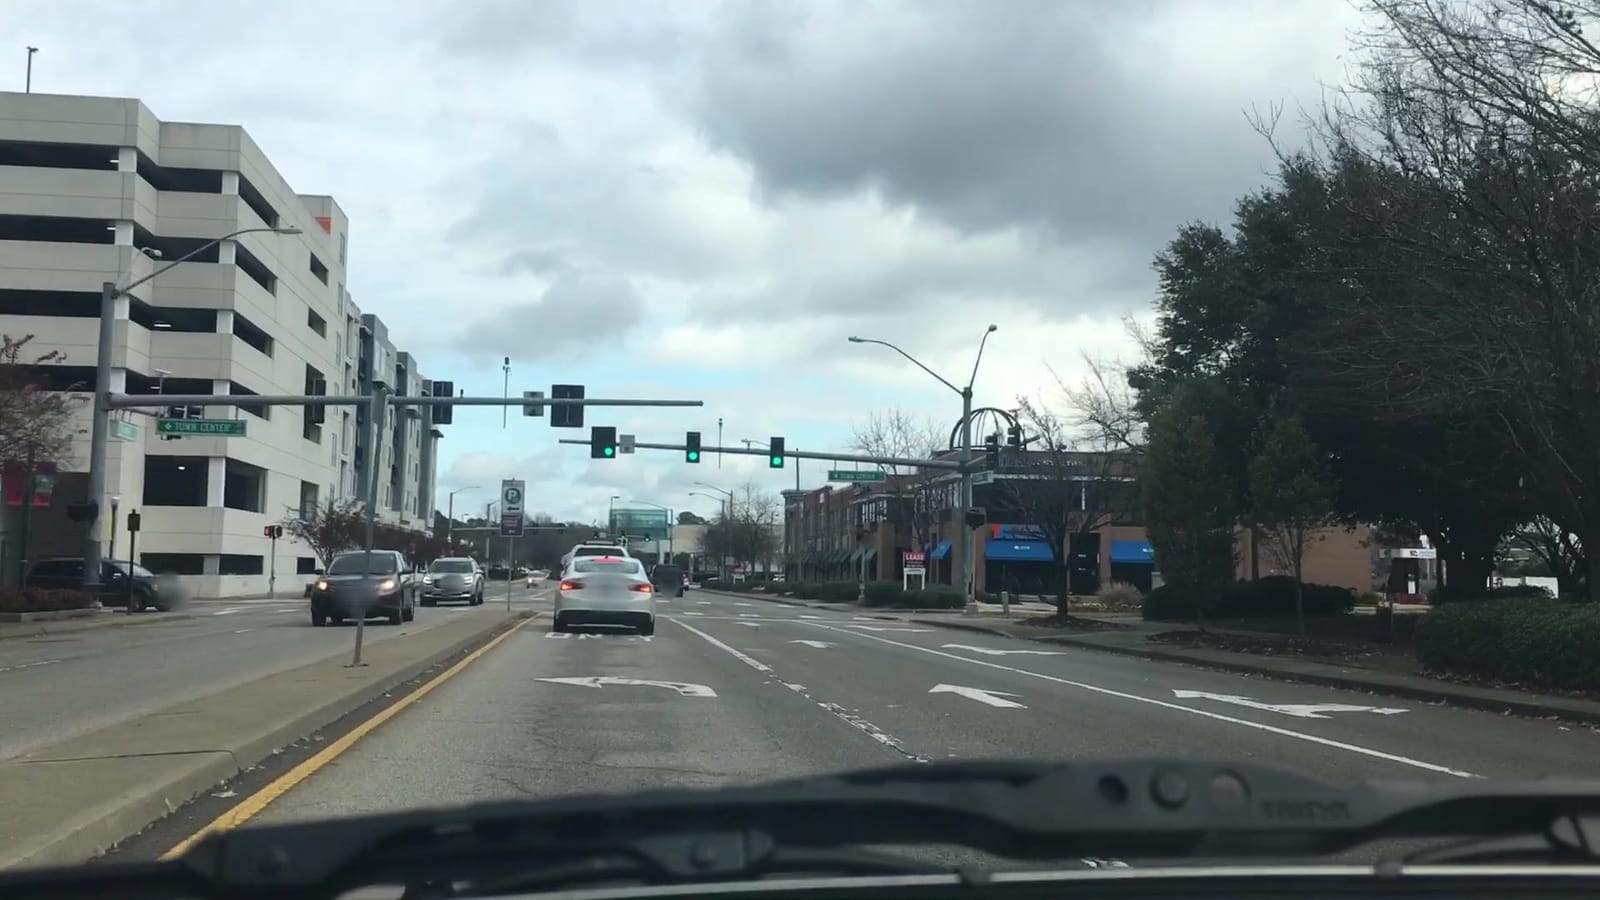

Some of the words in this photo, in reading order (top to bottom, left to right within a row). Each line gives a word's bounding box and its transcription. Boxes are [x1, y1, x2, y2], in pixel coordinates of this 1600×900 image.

[175, 422, 197, 432] TOWN
[200, 423, 231, 433] CENTER
[905, 552, 924, 560] LEASE
